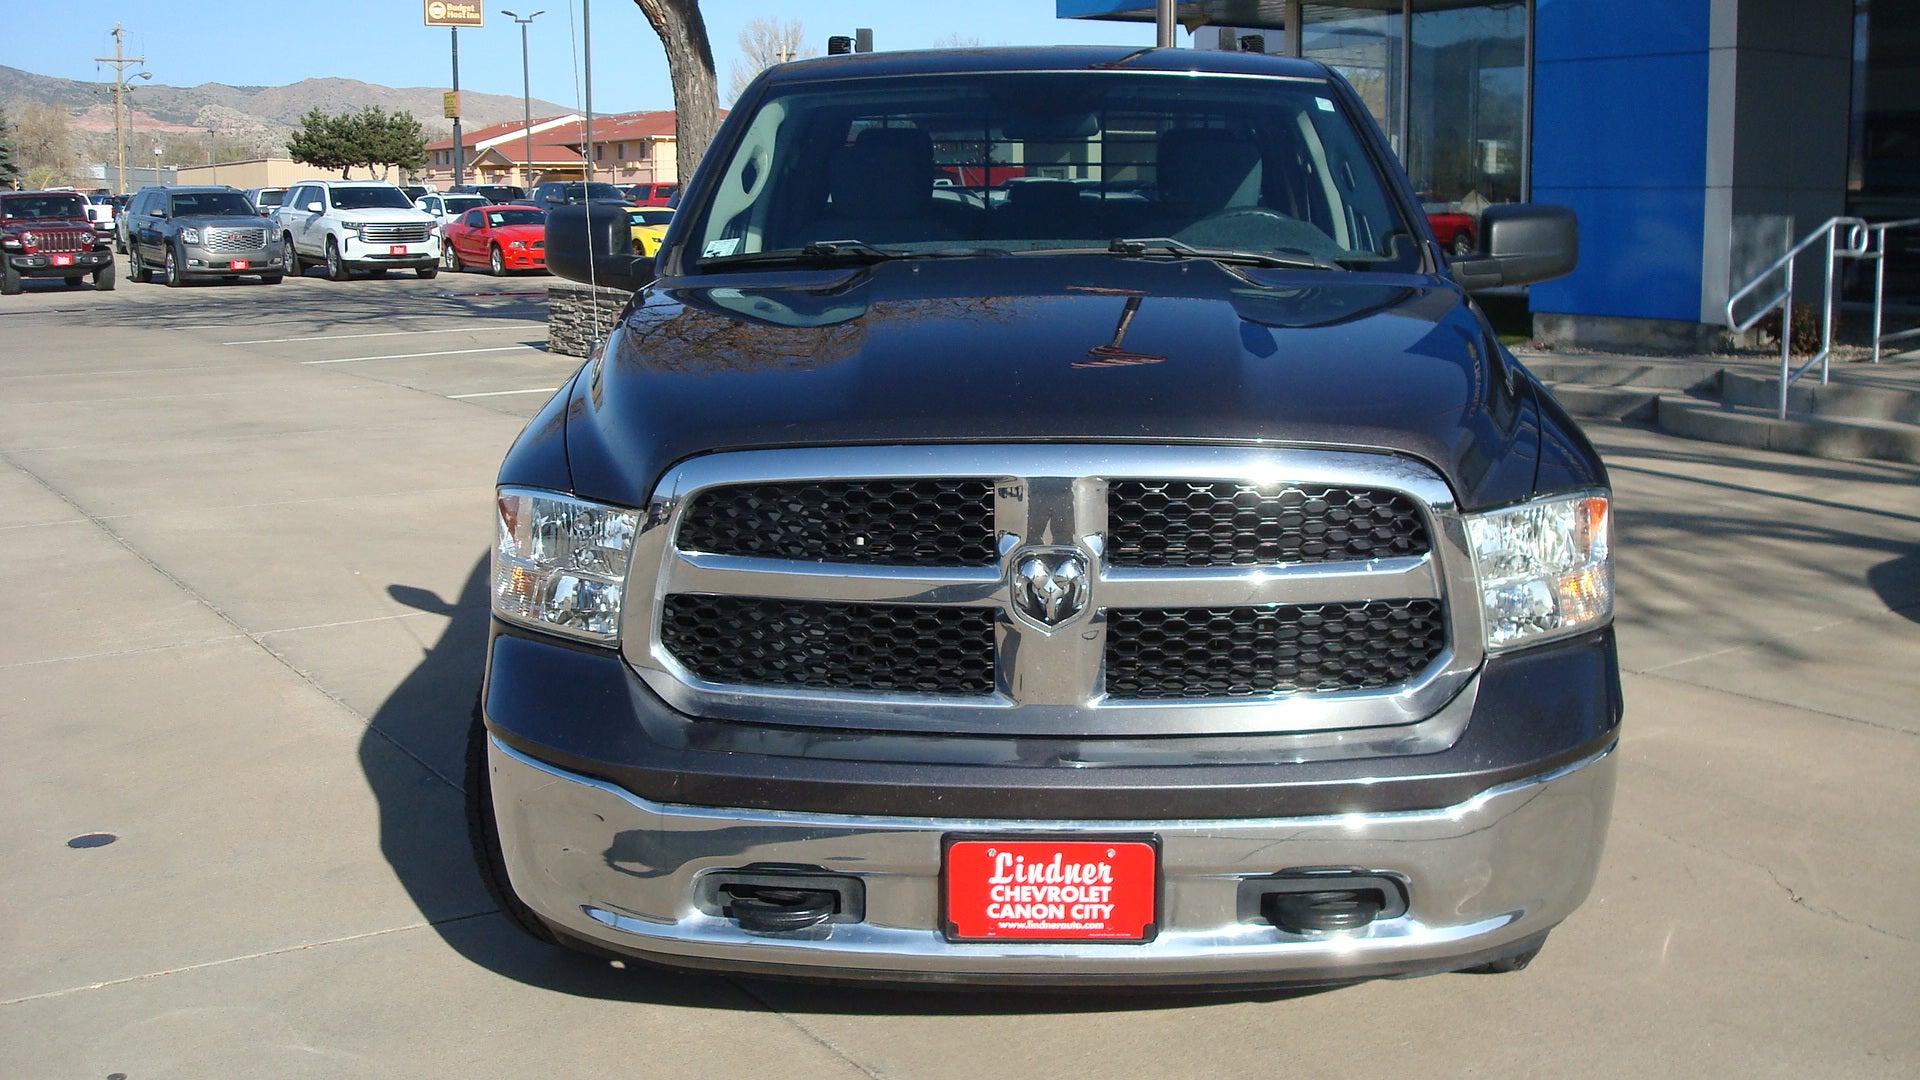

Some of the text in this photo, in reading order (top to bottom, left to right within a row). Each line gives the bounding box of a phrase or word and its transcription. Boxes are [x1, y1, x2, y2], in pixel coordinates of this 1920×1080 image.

[446, 3, 475, 12] Budget
[447, 11, 466, 19] Host
[988, 852, 1114, 885] Lindner
[990, 886, 1112, 903] CHEVROLET
[986, 903, 1115, 920] CANON CITY
[998, 920, 1104, 930] www.lindnerauto.com
